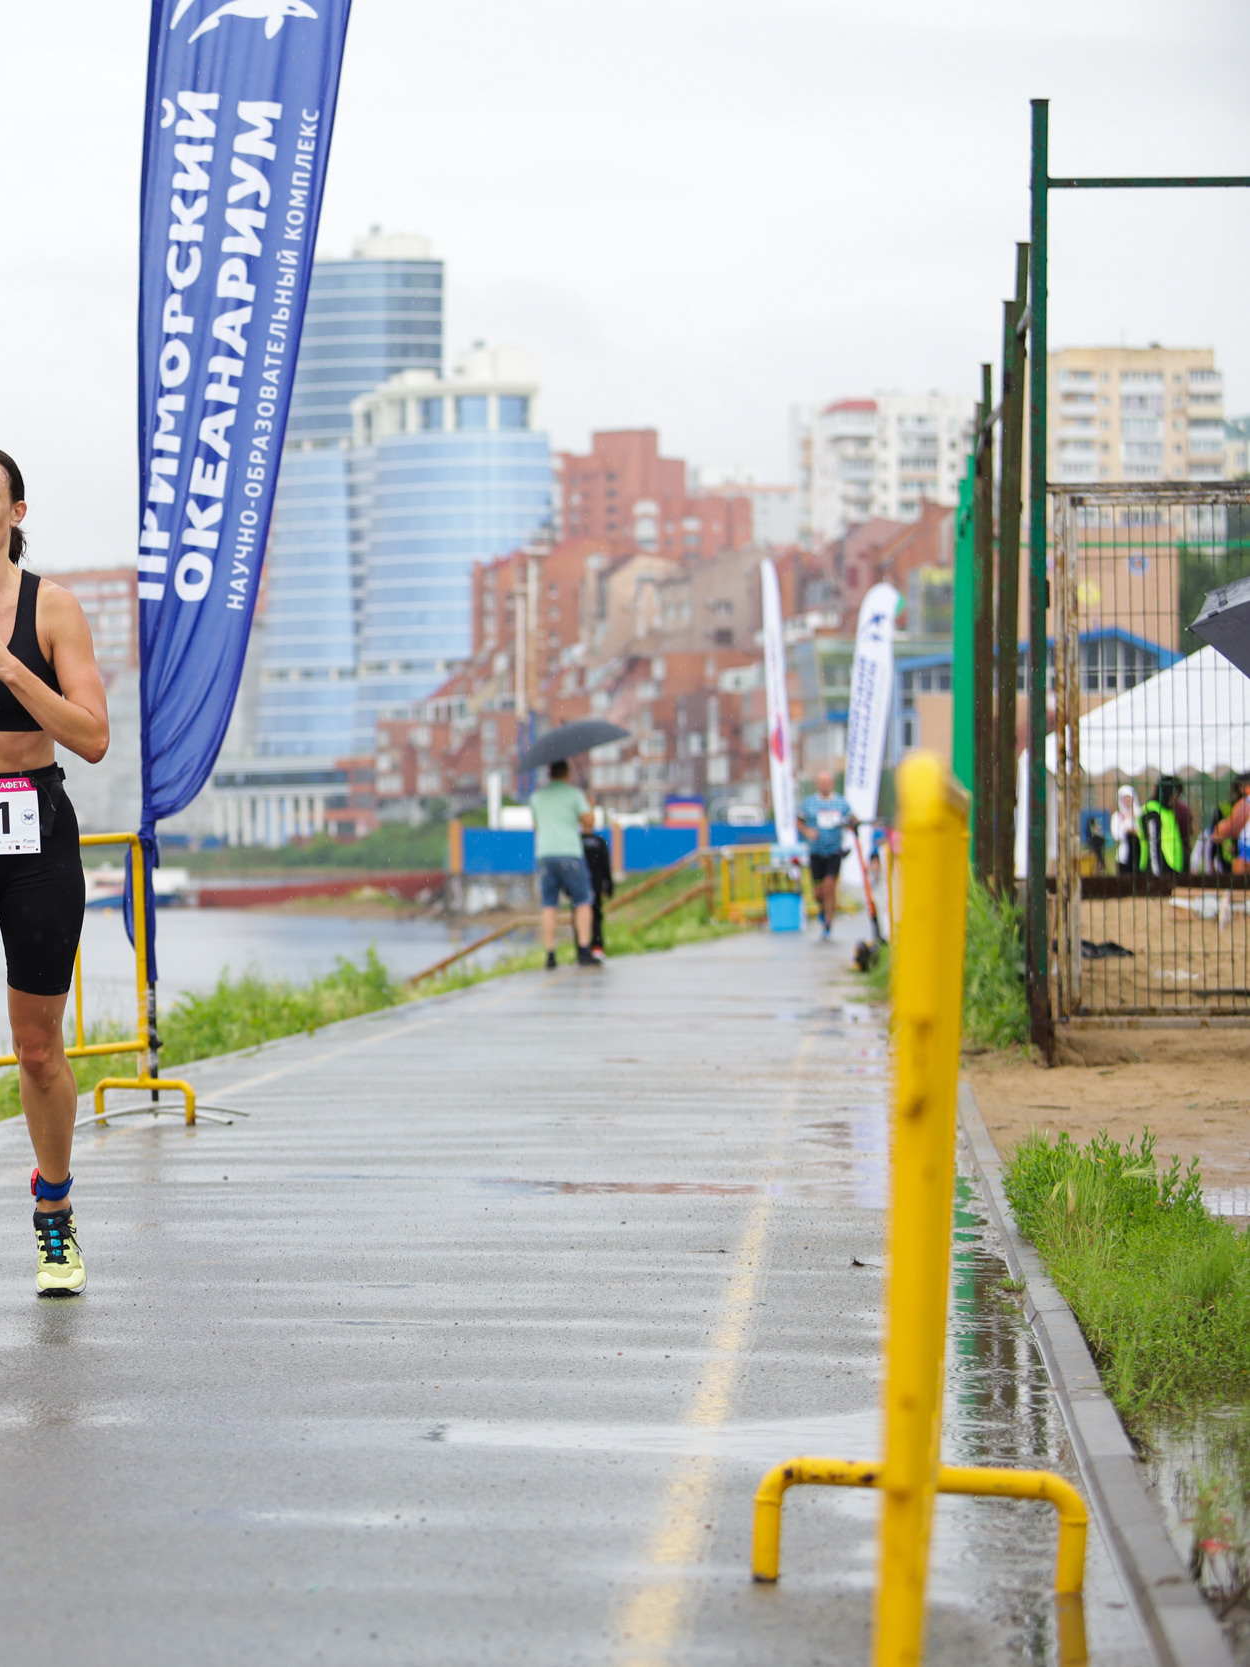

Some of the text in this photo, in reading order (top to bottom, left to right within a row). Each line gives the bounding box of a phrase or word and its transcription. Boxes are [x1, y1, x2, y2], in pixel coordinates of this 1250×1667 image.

[137, 90, 220, 602] ПРИМОРСКИЙ
[174, 100, 284, 603] ОКЕАНАРИУМ
[226, 108, 320, 610] НАУЧНО-ОБРАЗОВАТЕЛЬНЫЙ КОМПЛЕКС
